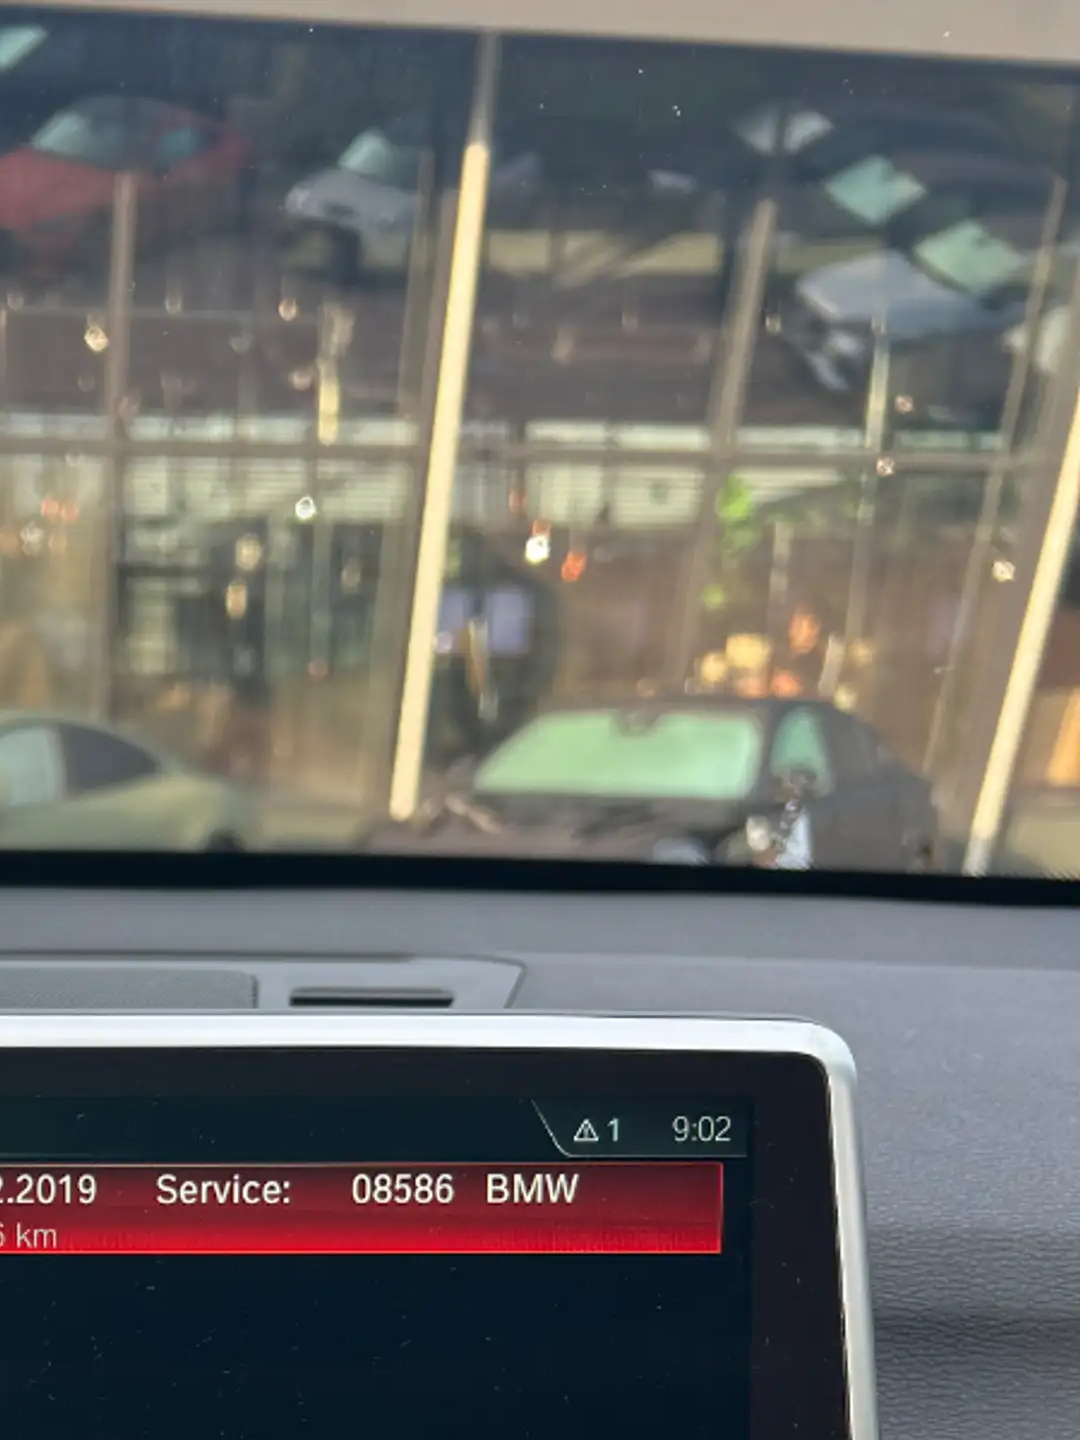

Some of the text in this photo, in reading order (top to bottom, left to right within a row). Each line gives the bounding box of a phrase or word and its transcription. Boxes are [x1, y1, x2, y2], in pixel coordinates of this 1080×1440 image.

[607, 1119, 620, 1142] 1
[672, 1116, 732, 1143] 9:02
[156, 1173, 579, 1204] Service: 08586 BMW
[16, 1221, 58, 1249] km
